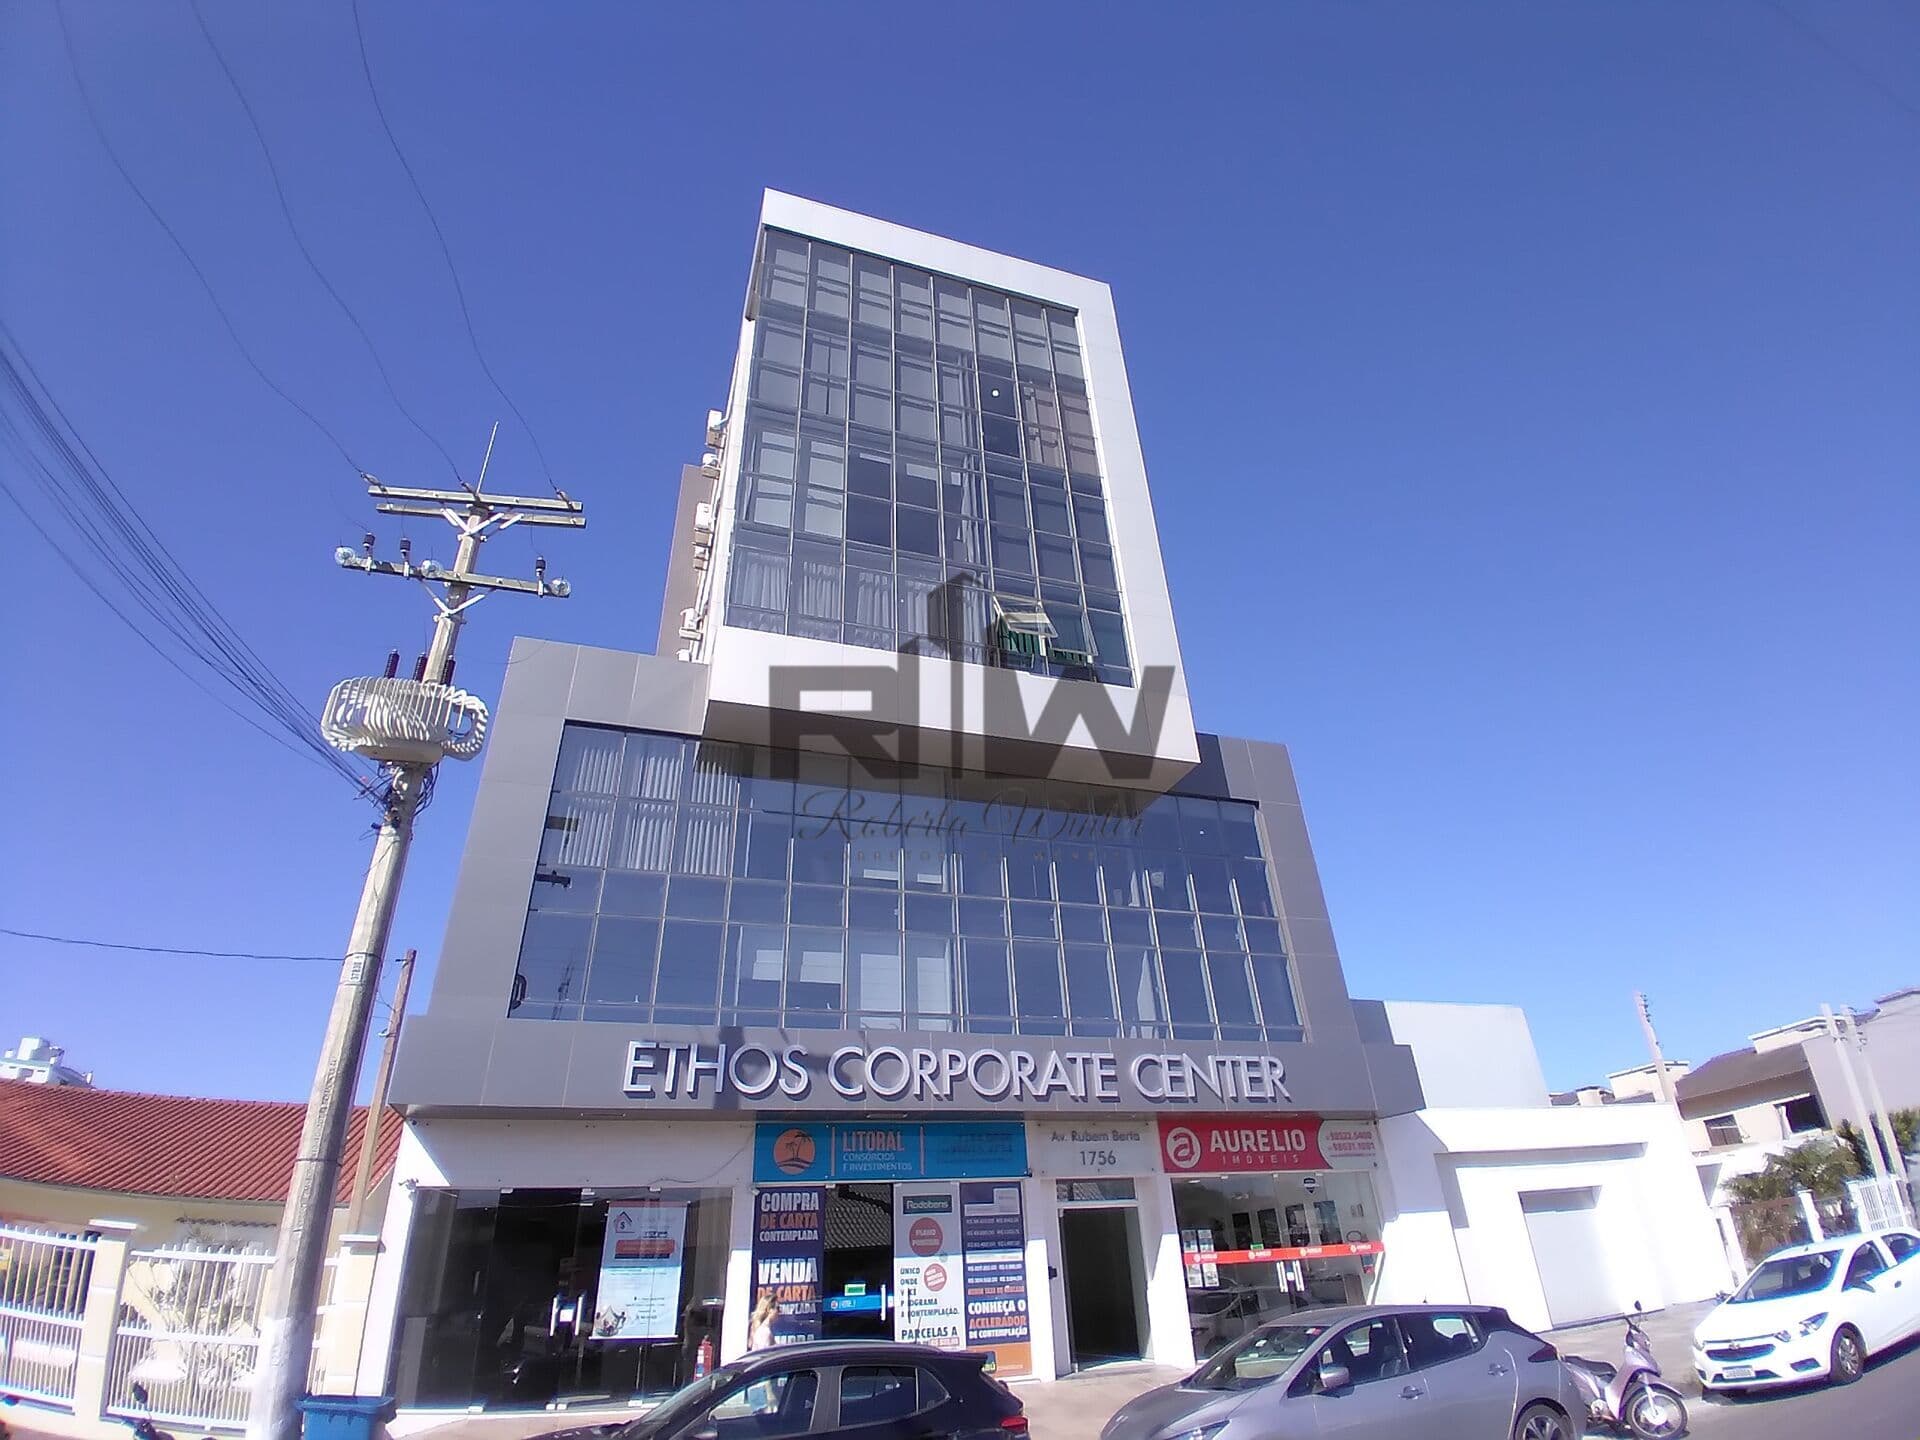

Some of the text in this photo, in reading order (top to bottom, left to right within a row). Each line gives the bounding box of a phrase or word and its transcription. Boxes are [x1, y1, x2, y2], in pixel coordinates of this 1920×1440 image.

[622, 1040, 1292, 1101] ETHOS CORPORATE CENTER
[842, 1131, 904, 1152] LITORAL
[1210, 1129, 1306, 1153] AURELIO
[1080, 1150, 1117, 1165] 1756
[761, 1192, 820, 1212] COMPRA
[760, 1213, 818, 1229] DE CARTA
[760, 1230, 819, 1242] CONTEMPLADA
[758, 1258, 818, 1284] VENDA
[900, 1278, 918, 1286] ONDE
[776, 1285, 817, 1302] CARTA
[900, 1298, 938, 1307] POGRAMA
[968, 1299, 1027, 1316] CONHEÇA O
[969, 1315, 1027, 1330] ACELERADOR
[901, 1326, 958, 1341] PARCELAS A
[978, 1326, 1028, 1339] CONTEMPLAÇÃO
